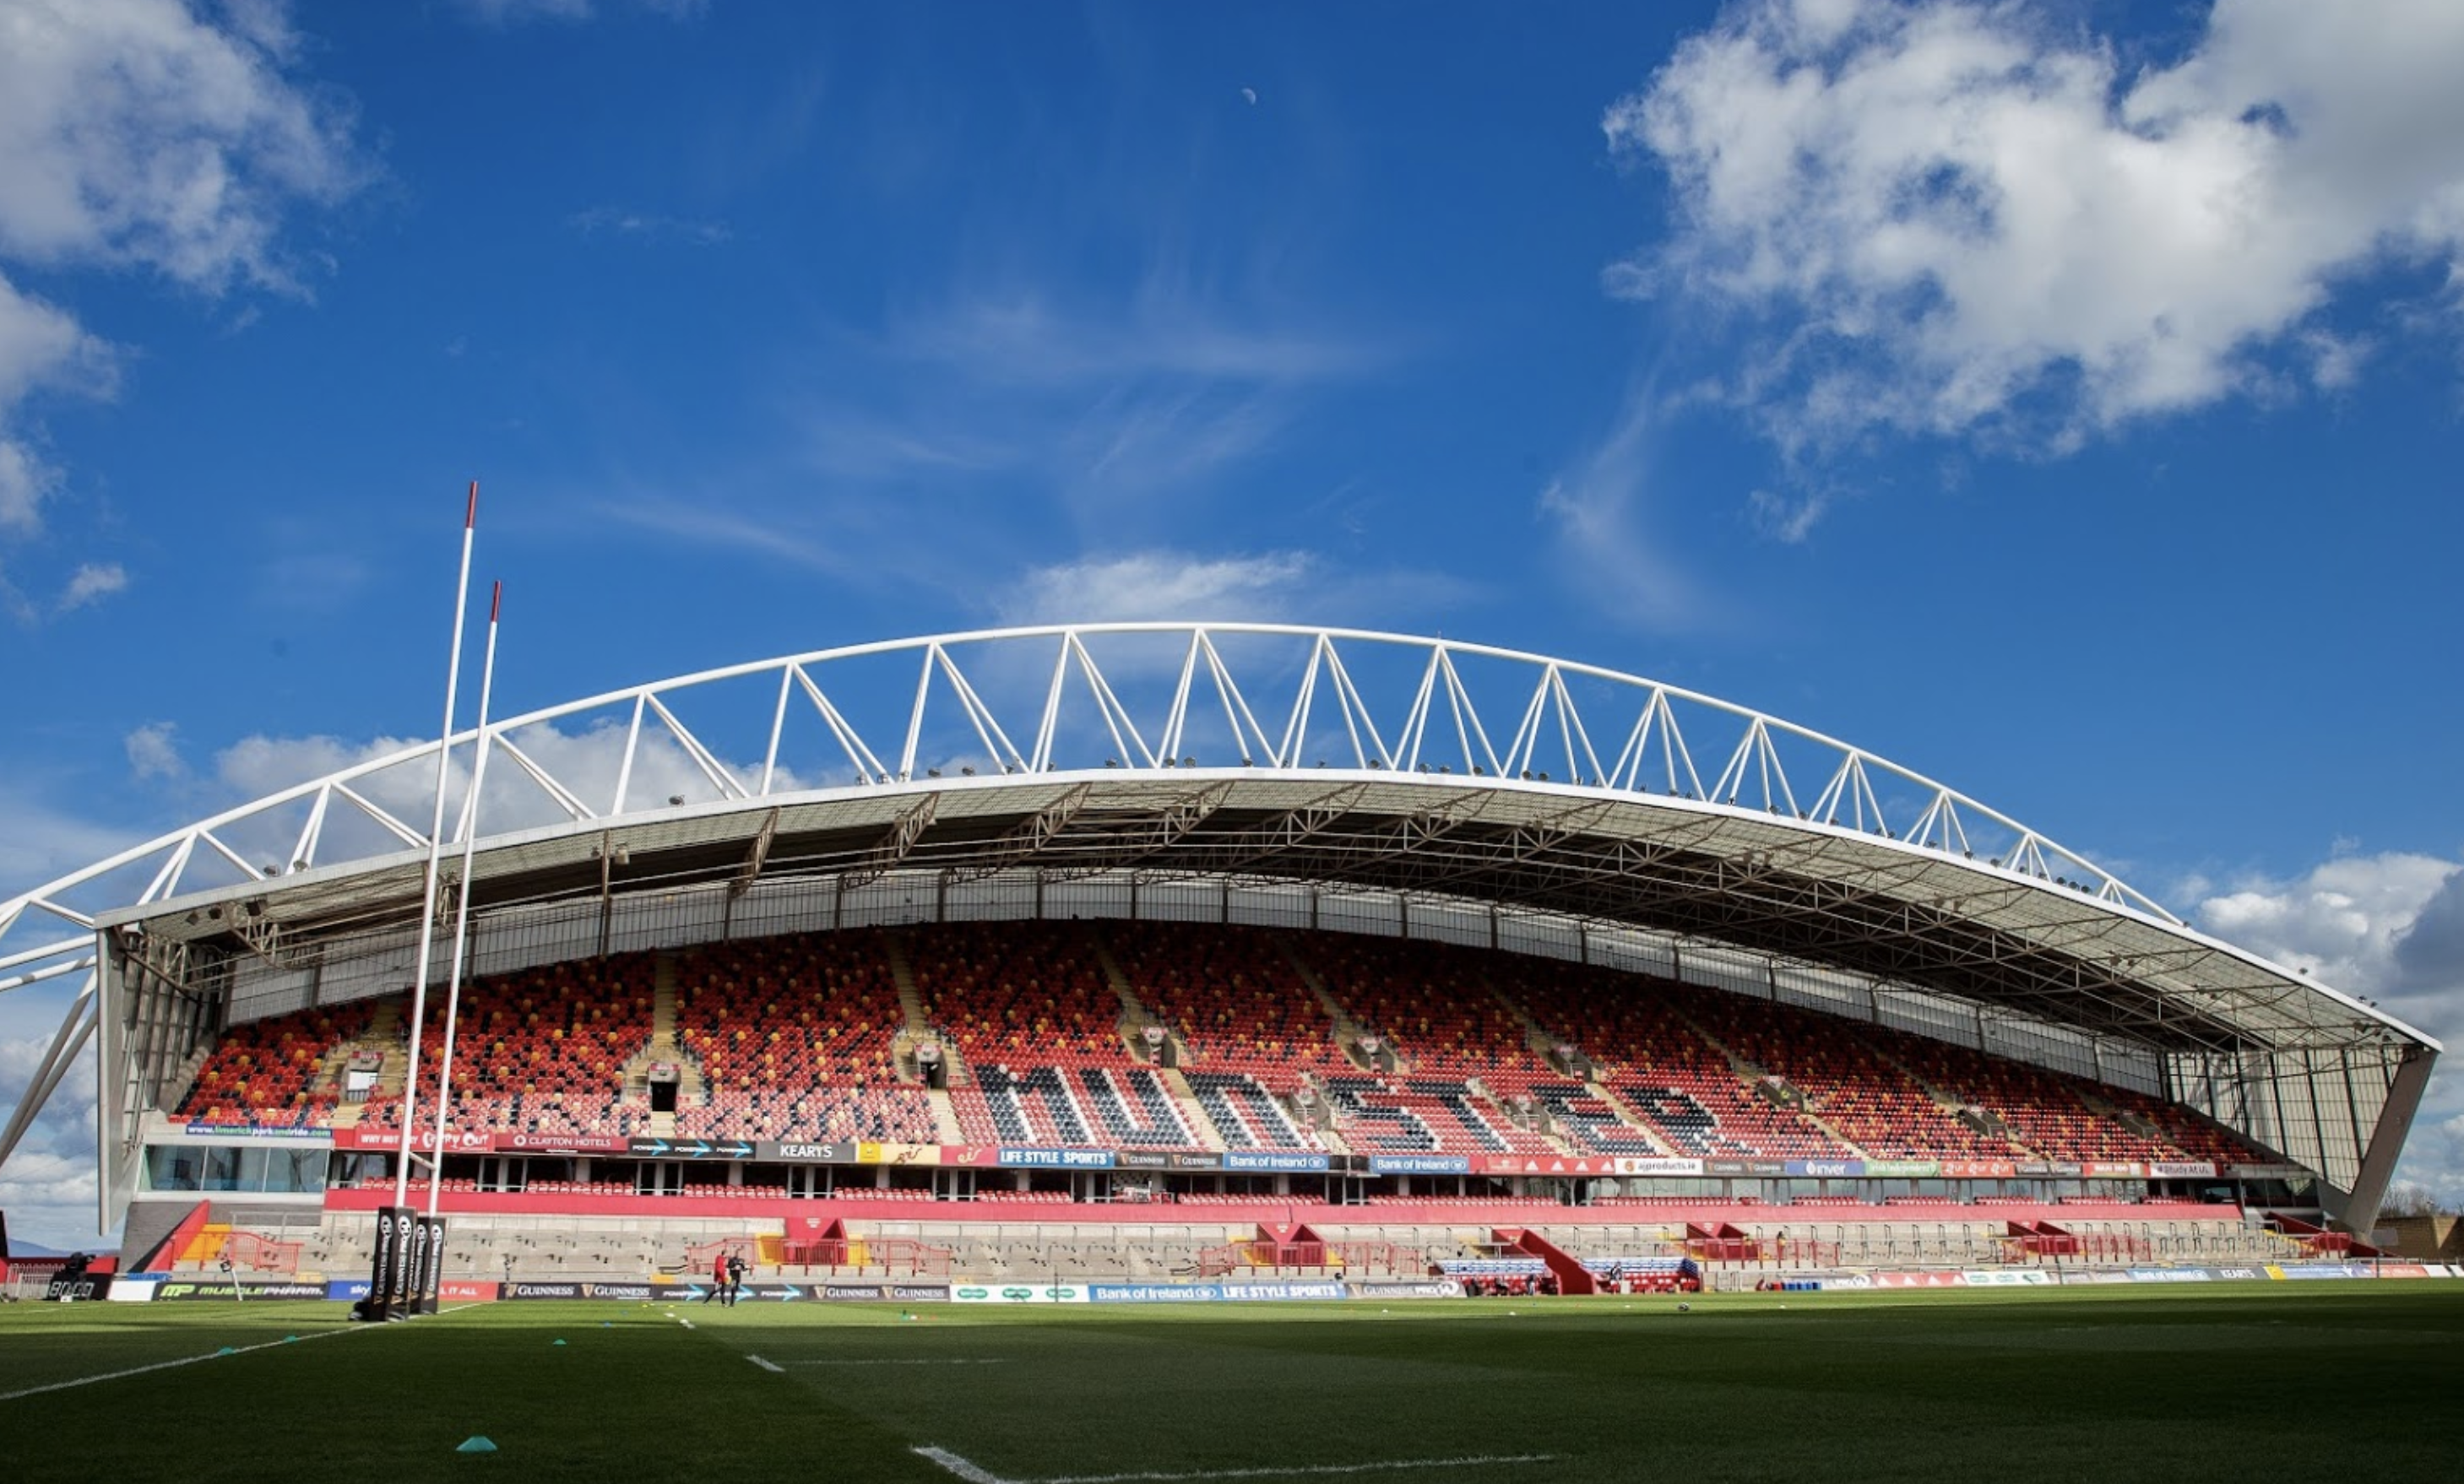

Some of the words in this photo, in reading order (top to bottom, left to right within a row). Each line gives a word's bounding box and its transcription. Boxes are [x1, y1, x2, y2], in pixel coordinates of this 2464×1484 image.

[361, 1135, 380, 1143] WHY
[529, 1136, 572, 1146] CLAYTON
[576, 1138, 611, 1147] HOTELS
[957, 1147, 982, 1164] eir
[1000, 1151, 1023, 1162] LIFE
[1023, 1151, 1059, 1163] STYLE
[1062, 1151, 1107, 1165] SPORTS
[1229, 1156, 1256, 1167] Bank
[1257, 1156, 1270, 1167] of
[1271, 1156, 1306, 1168] Ireland
[1377, 1160, 1403, 1169] Bank
[1403, 1160, 1415, 1169] of
[1415, 1160, 1449, 1170] Ireland
[1638, 1162, 1696, 1172] ajproducts.ie
[350, 1284, 371, 1295] sky
[448, 1286, 457, 1295] IT
[459, 1286, 477, 1295] ALL
[518, 1285, 574, 1296] GUINNESS
[594, 1285, 650, 1296] GUINNESS
[826, 1287, 878, 1297] GUINNESS
[894, 1287, 945, 1297] GUINNESS
[1096, 1287, 1132, 1299] Bank
[1132, 1287, 1148, 1299] of
[1148, 1287, 1195, 1299] Ireland
[1222, 1285, 1248, 1297] LIFE
[1250, 1285, 1288, 1297] STYLE
[1289, 1284, 1337, 1297] SPORTS
[1363, 1284, 1414, 1295] GUINNESS
